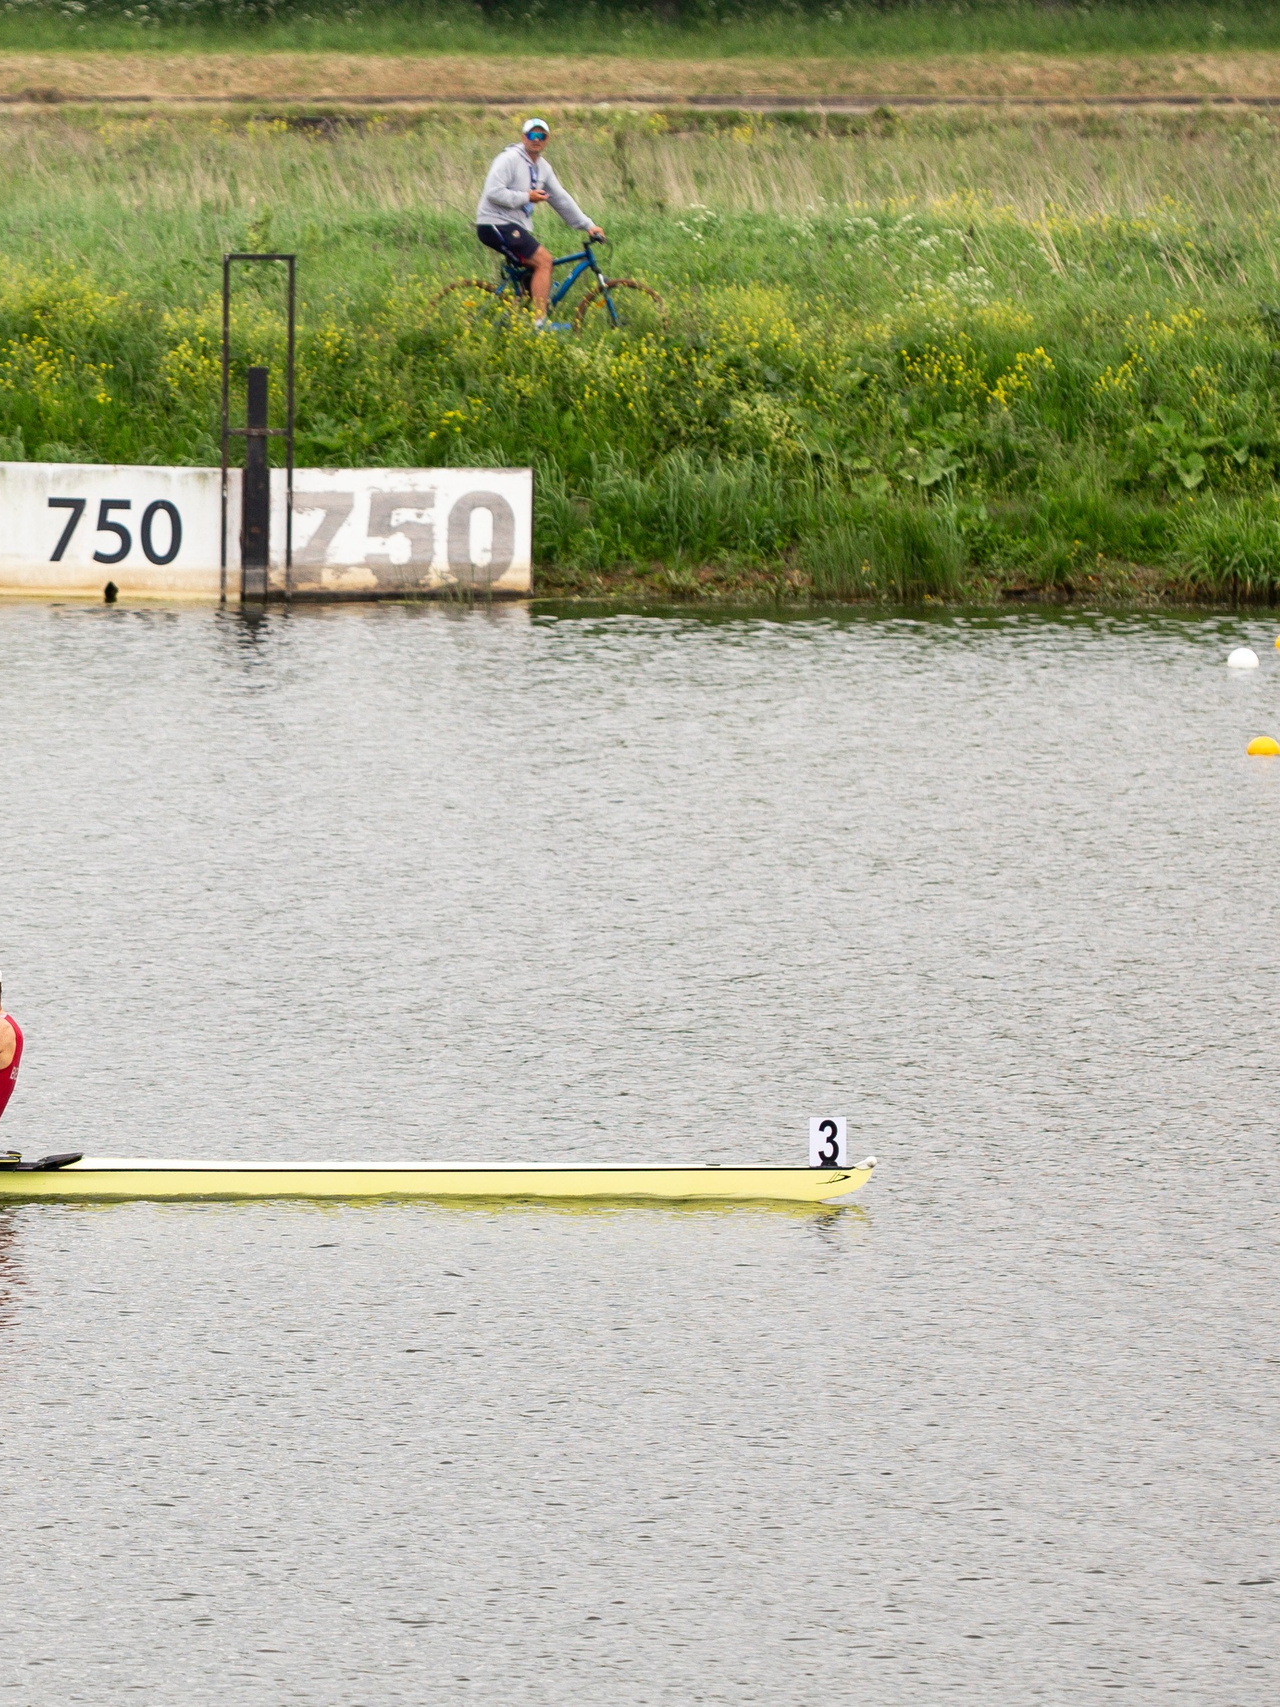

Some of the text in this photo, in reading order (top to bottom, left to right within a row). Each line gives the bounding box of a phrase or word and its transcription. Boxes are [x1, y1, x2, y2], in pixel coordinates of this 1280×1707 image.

[47, 496, 183, 566] 750
[291, 490, 516, 588] 750
[818, 1119, 840, 1163] 3
